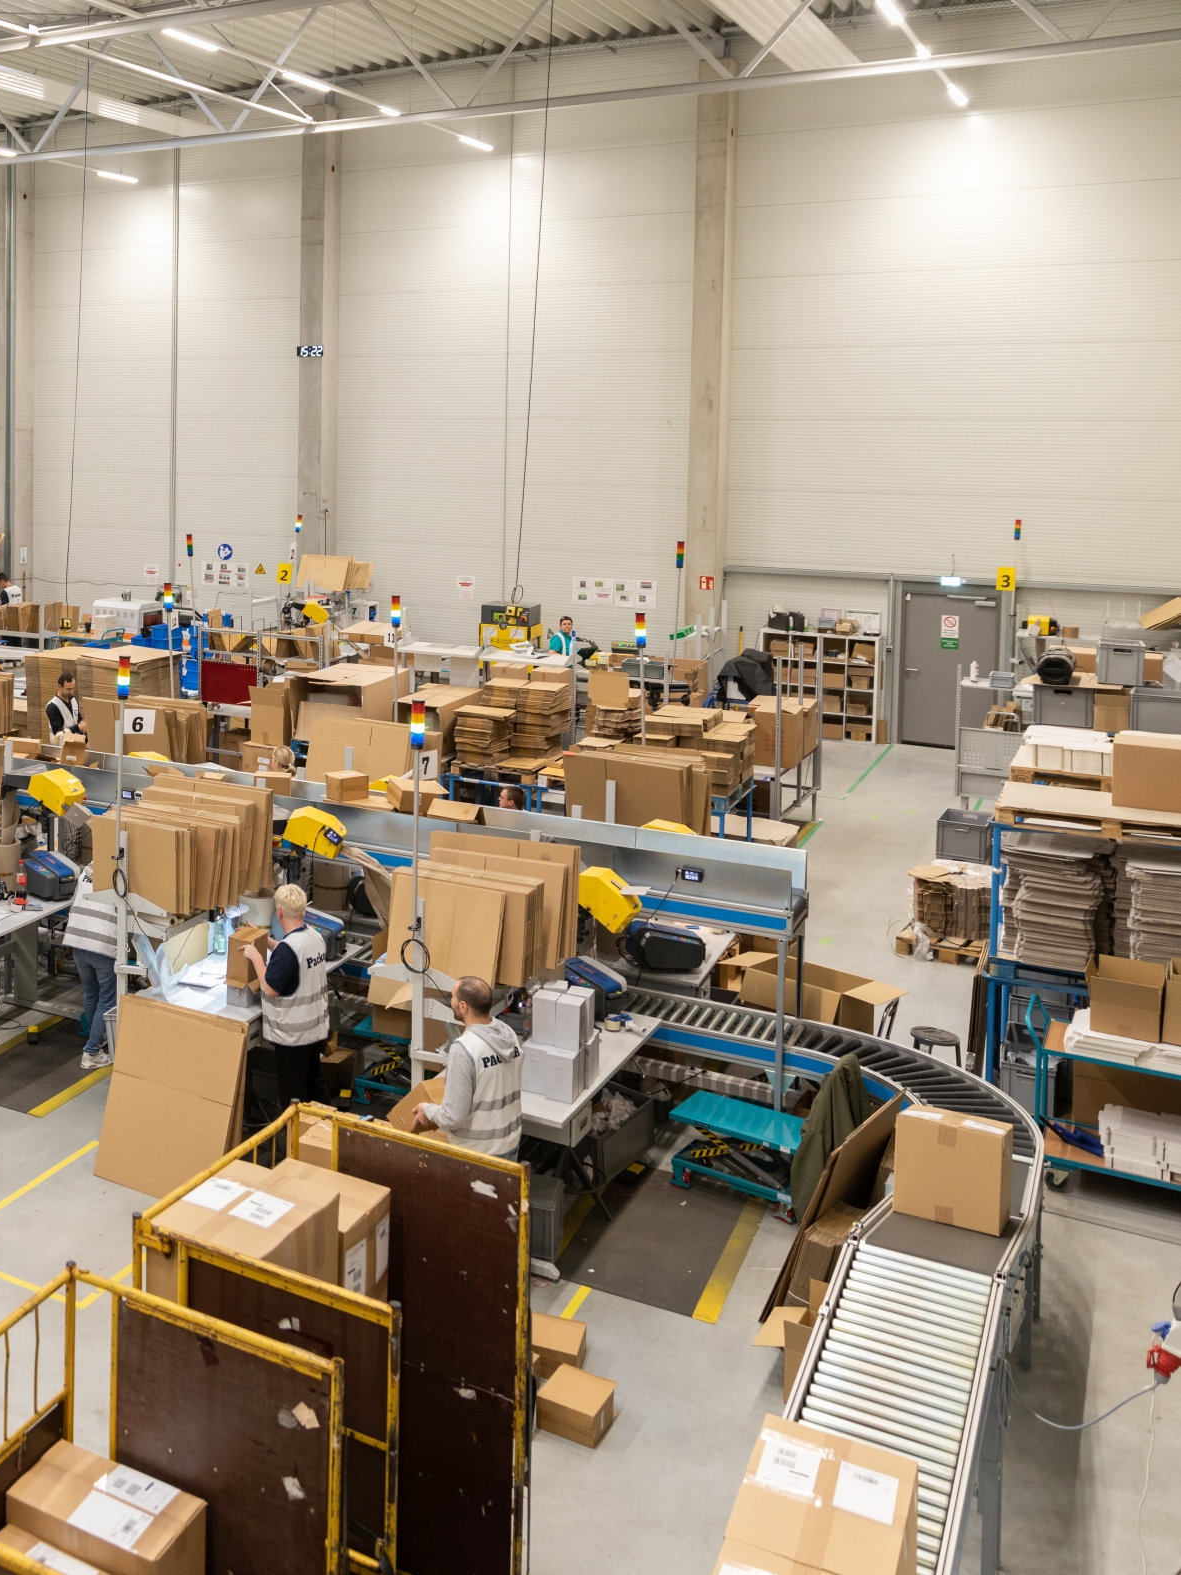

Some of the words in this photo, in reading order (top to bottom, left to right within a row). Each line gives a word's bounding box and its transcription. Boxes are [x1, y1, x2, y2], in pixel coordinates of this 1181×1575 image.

[300, 346, 323, 356] 15:22
[280, 570, 288, 581] 2
[1001, 575, 1010, 588] 3
[132, 717, 143, 732] 6
[422, 756, 430, 775] 7
[482, 1046, 520, 1068] PACR
